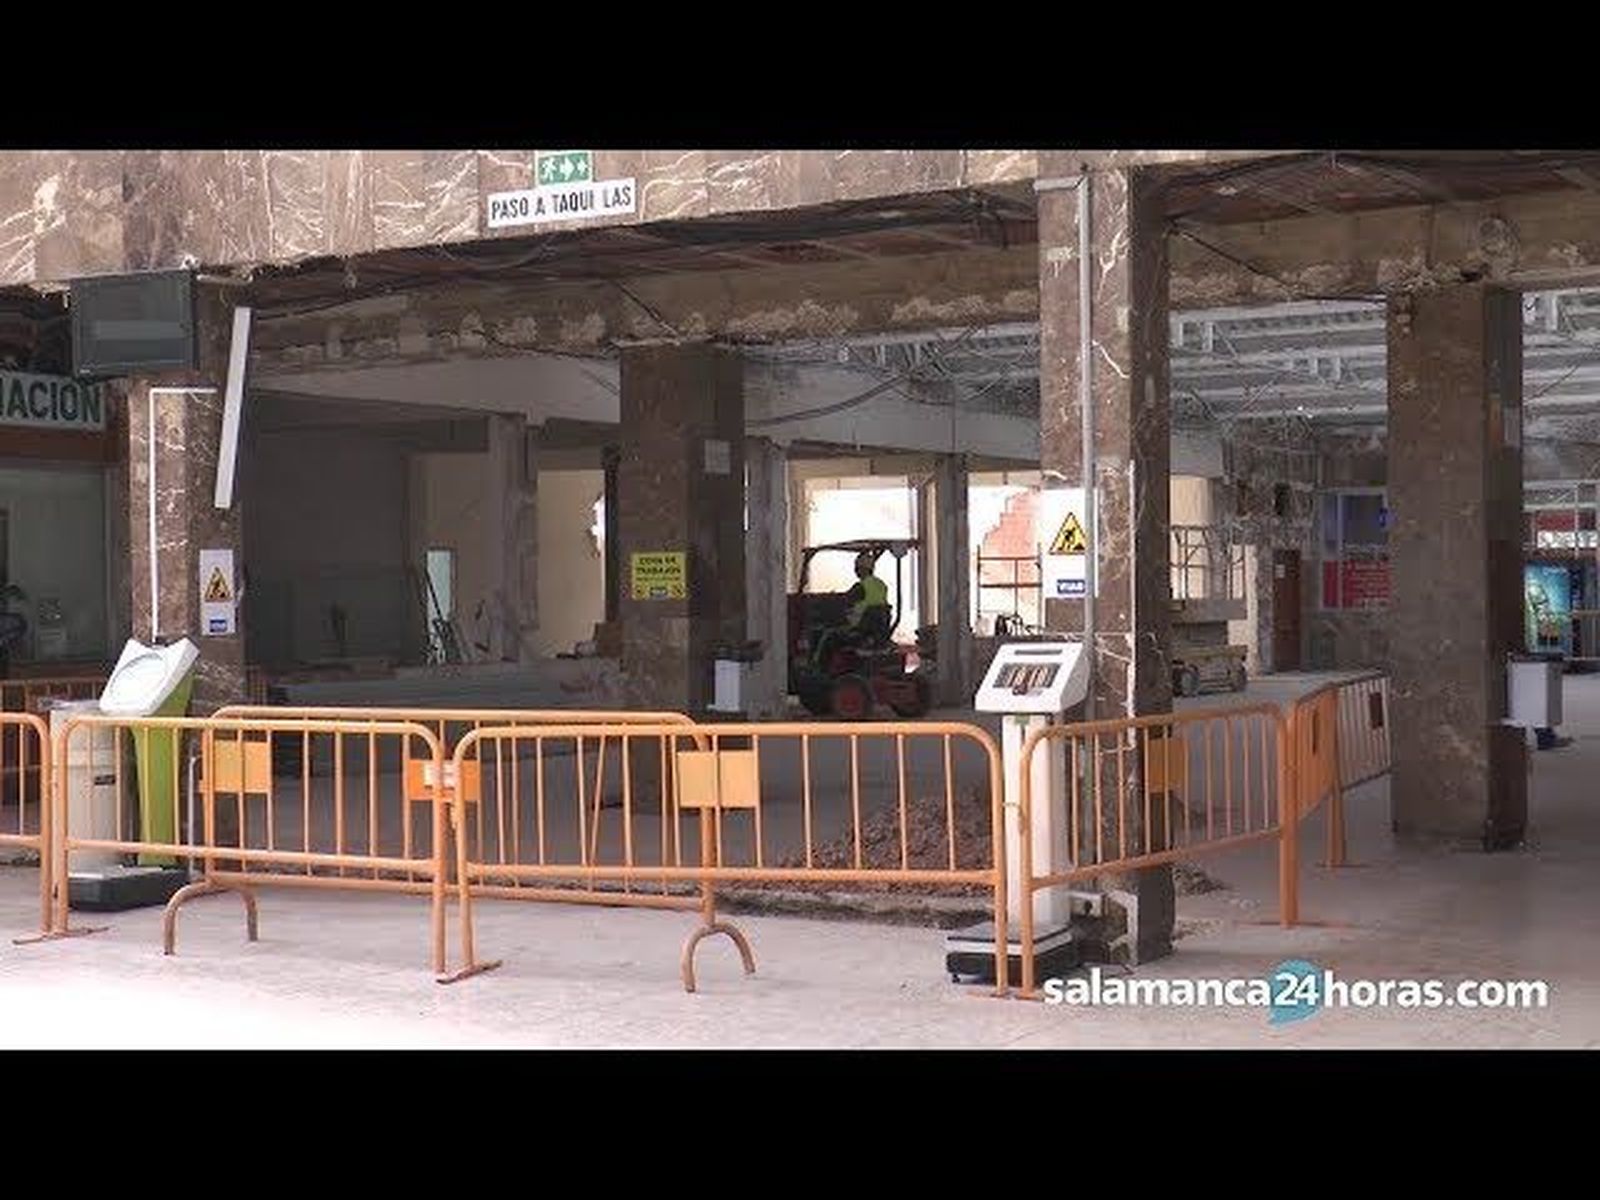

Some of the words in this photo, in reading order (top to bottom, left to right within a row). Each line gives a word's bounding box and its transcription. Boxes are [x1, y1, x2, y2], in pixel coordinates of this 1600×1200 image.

[491, 197, 529, 220] PASO
[535, 197, 546, 215] A
[0, 378, 100, 422] ACION
